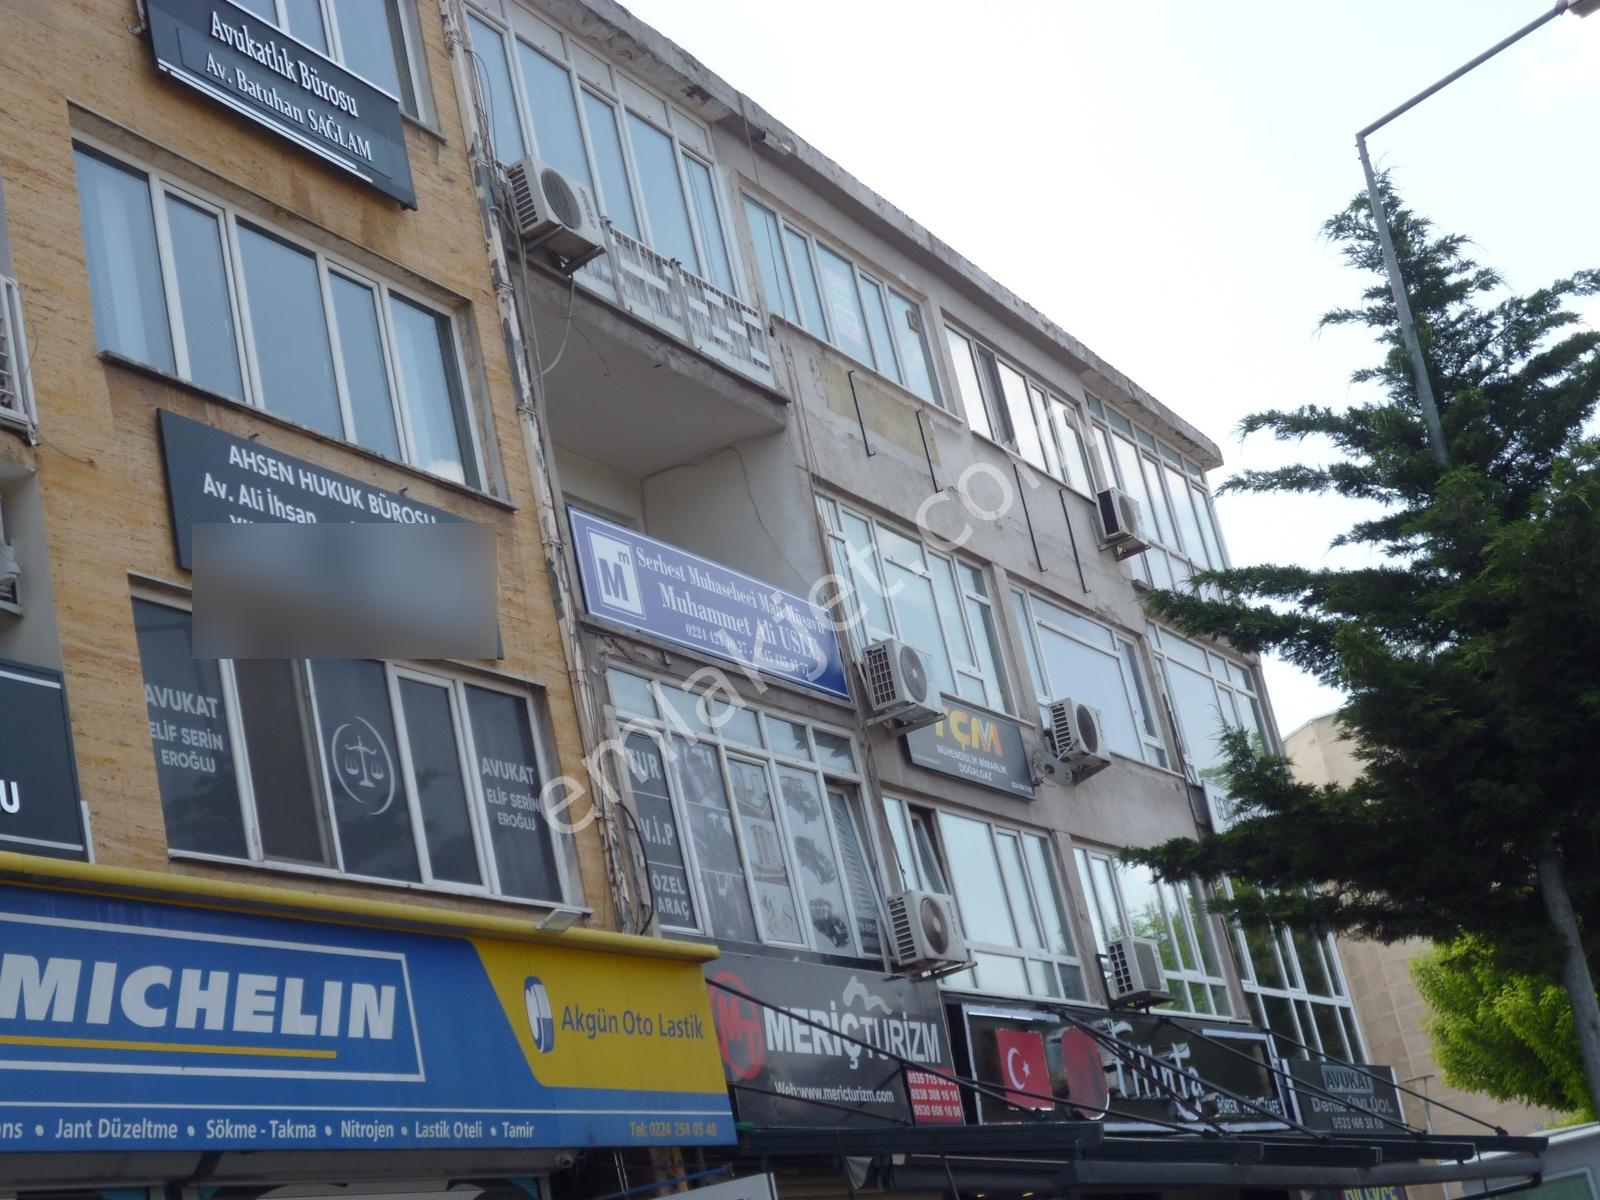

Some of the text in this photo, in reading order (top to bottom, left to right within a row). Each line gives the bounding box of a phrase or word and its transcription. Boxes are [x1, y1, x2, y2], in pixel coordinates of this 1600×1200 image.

[210, 10, 359, 117] Avukatlık Bürosu
[236, 68, 304, 124] Batuhan
[307, 109, 373, 162] SAĞLAM
[229, 445, 295, 486] AHSEN
[299, 469, 365, 510] HUKUK
[203, 472, 317, 523] Av. Ali İhsan
[636, 546, 686, 582] Serbest
[688, 565, 758, 608] Muhasebeci
[658, 581, 752, 637] Muhammet
[756, 617, 777, 646] Ali
[144, 683, 219, 719] AVUKAT
[149, 720, 224, 751] ELİF SERİN
[160, 749, 216, 773] EROĞLU
[482, 757, 534, 785] AVUKAT
[486, 787, 541, 813] ELİF SERİN
[497, 812, 536, 831] EROĞLU
[652, 870, 686, 895] ÖZEL
[657, 897, 689, 920] ARAÇ
[0, 953, 396, 1040] MICHELIN
[561, 1004, 705, 1040] Akgün Oto Lastik
[0, 1121, 23, 1138] ns
[55, 1118, 93, 1139] Jant
[98, 1118, 178, 1139] Düzeltme
[206, 1120, 257, 1139] Sökme
[269, 1119, 316, 1138] Takma
[341, 1120, 394, 1143] Nitrojen
[415, 1120, 450, 1138] Lastik
[453, 1121, 482, 1138] Oteli
[502, 1121, 535, 1138] Tamir
